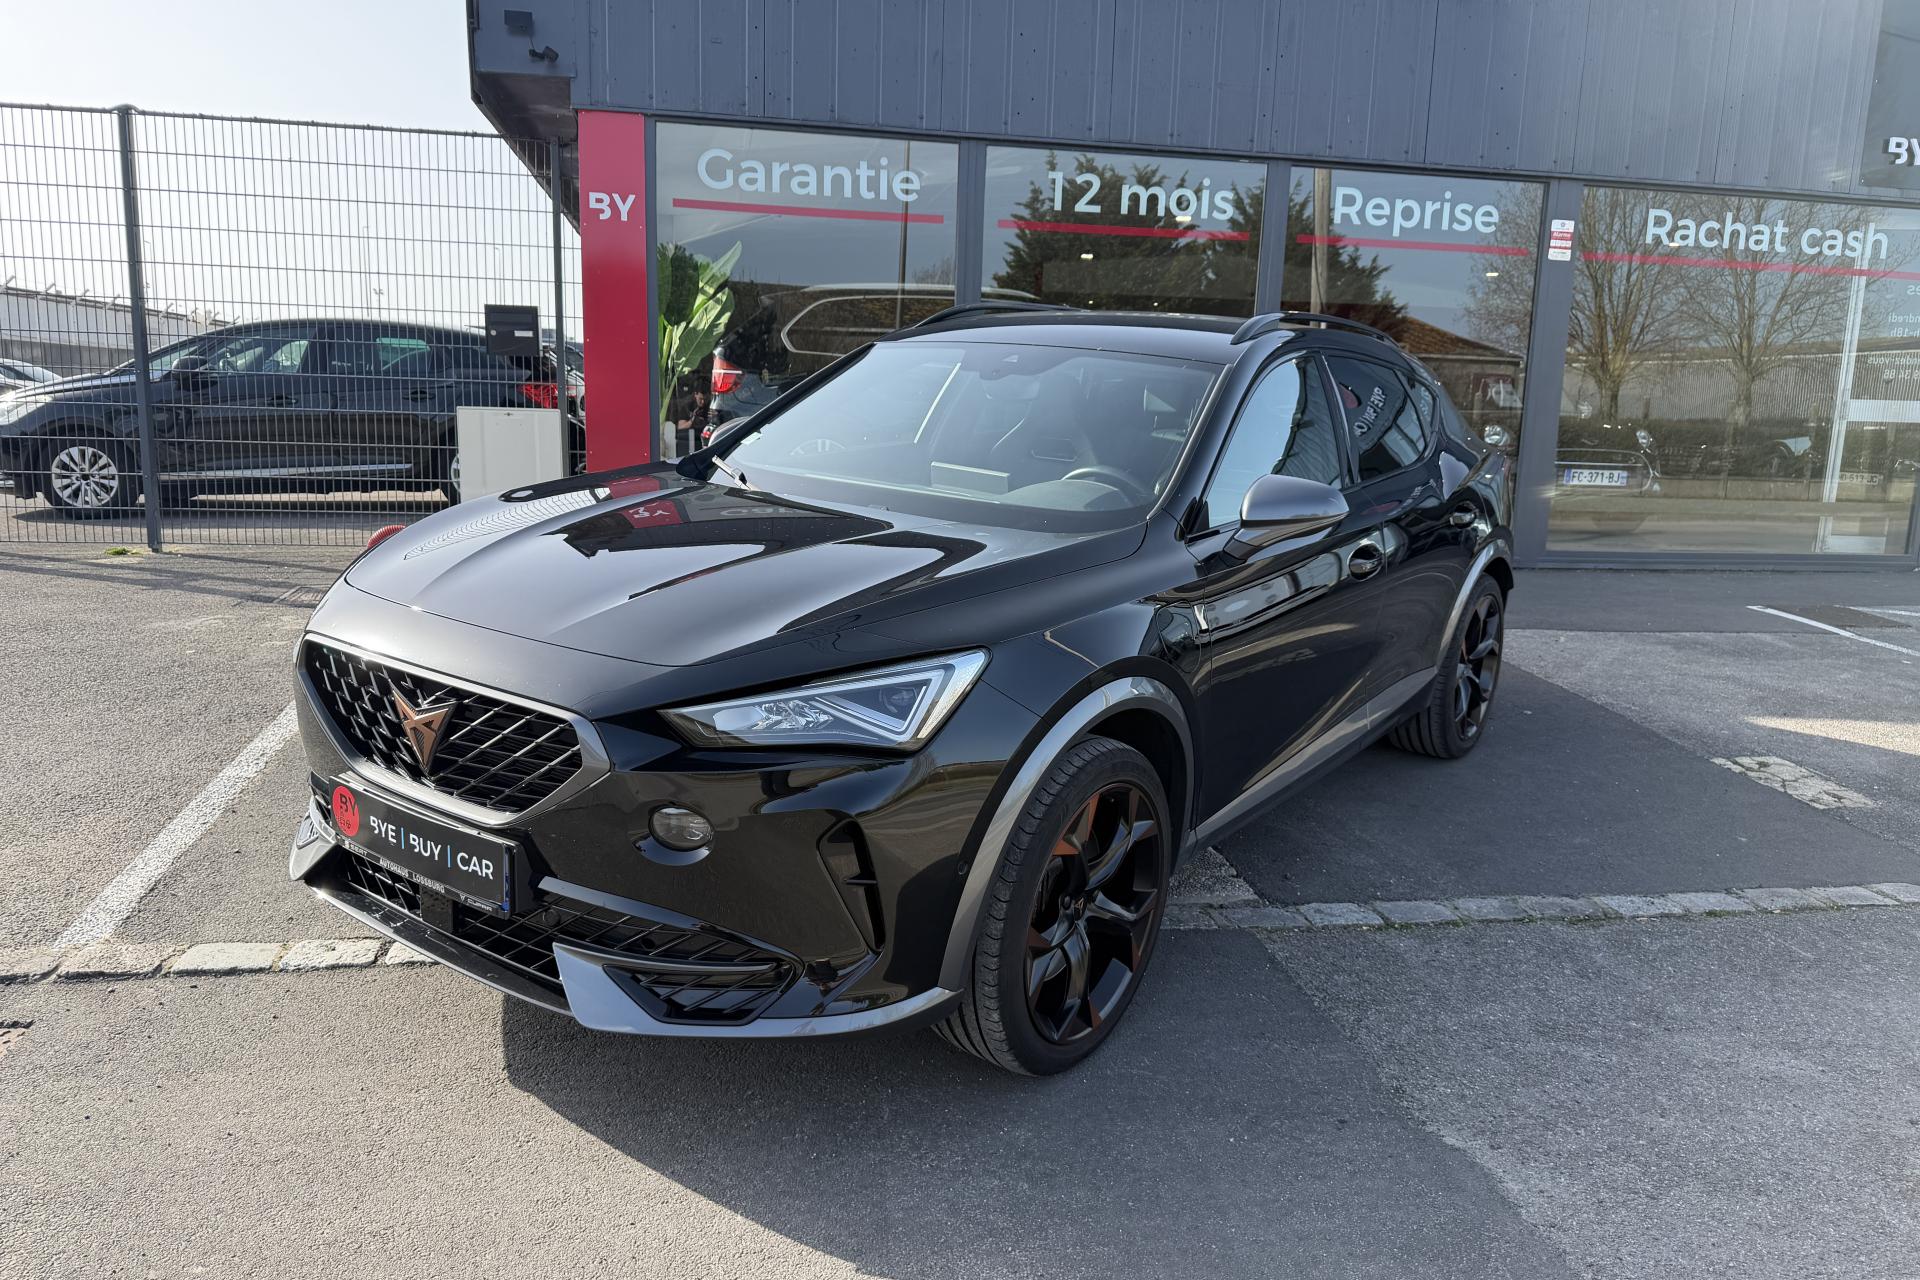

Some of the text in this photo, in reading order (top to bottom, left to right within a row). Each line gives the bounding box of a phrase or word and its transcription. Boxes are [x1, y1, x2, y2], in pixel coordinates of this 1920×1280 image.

[697, 148, 921, 201] Garantie
[1048, 171, 1234, 221] 12 mois
[588, 191, 636, 221] BY
[1333, 186, 1499, 237] Reprise
[1645, 208, 1889, 260] Rachat cash
[369, 815, 397, 843] BYE
[409, 833, 442, 861] BUY
[456, 852, 494, 880] CAR
